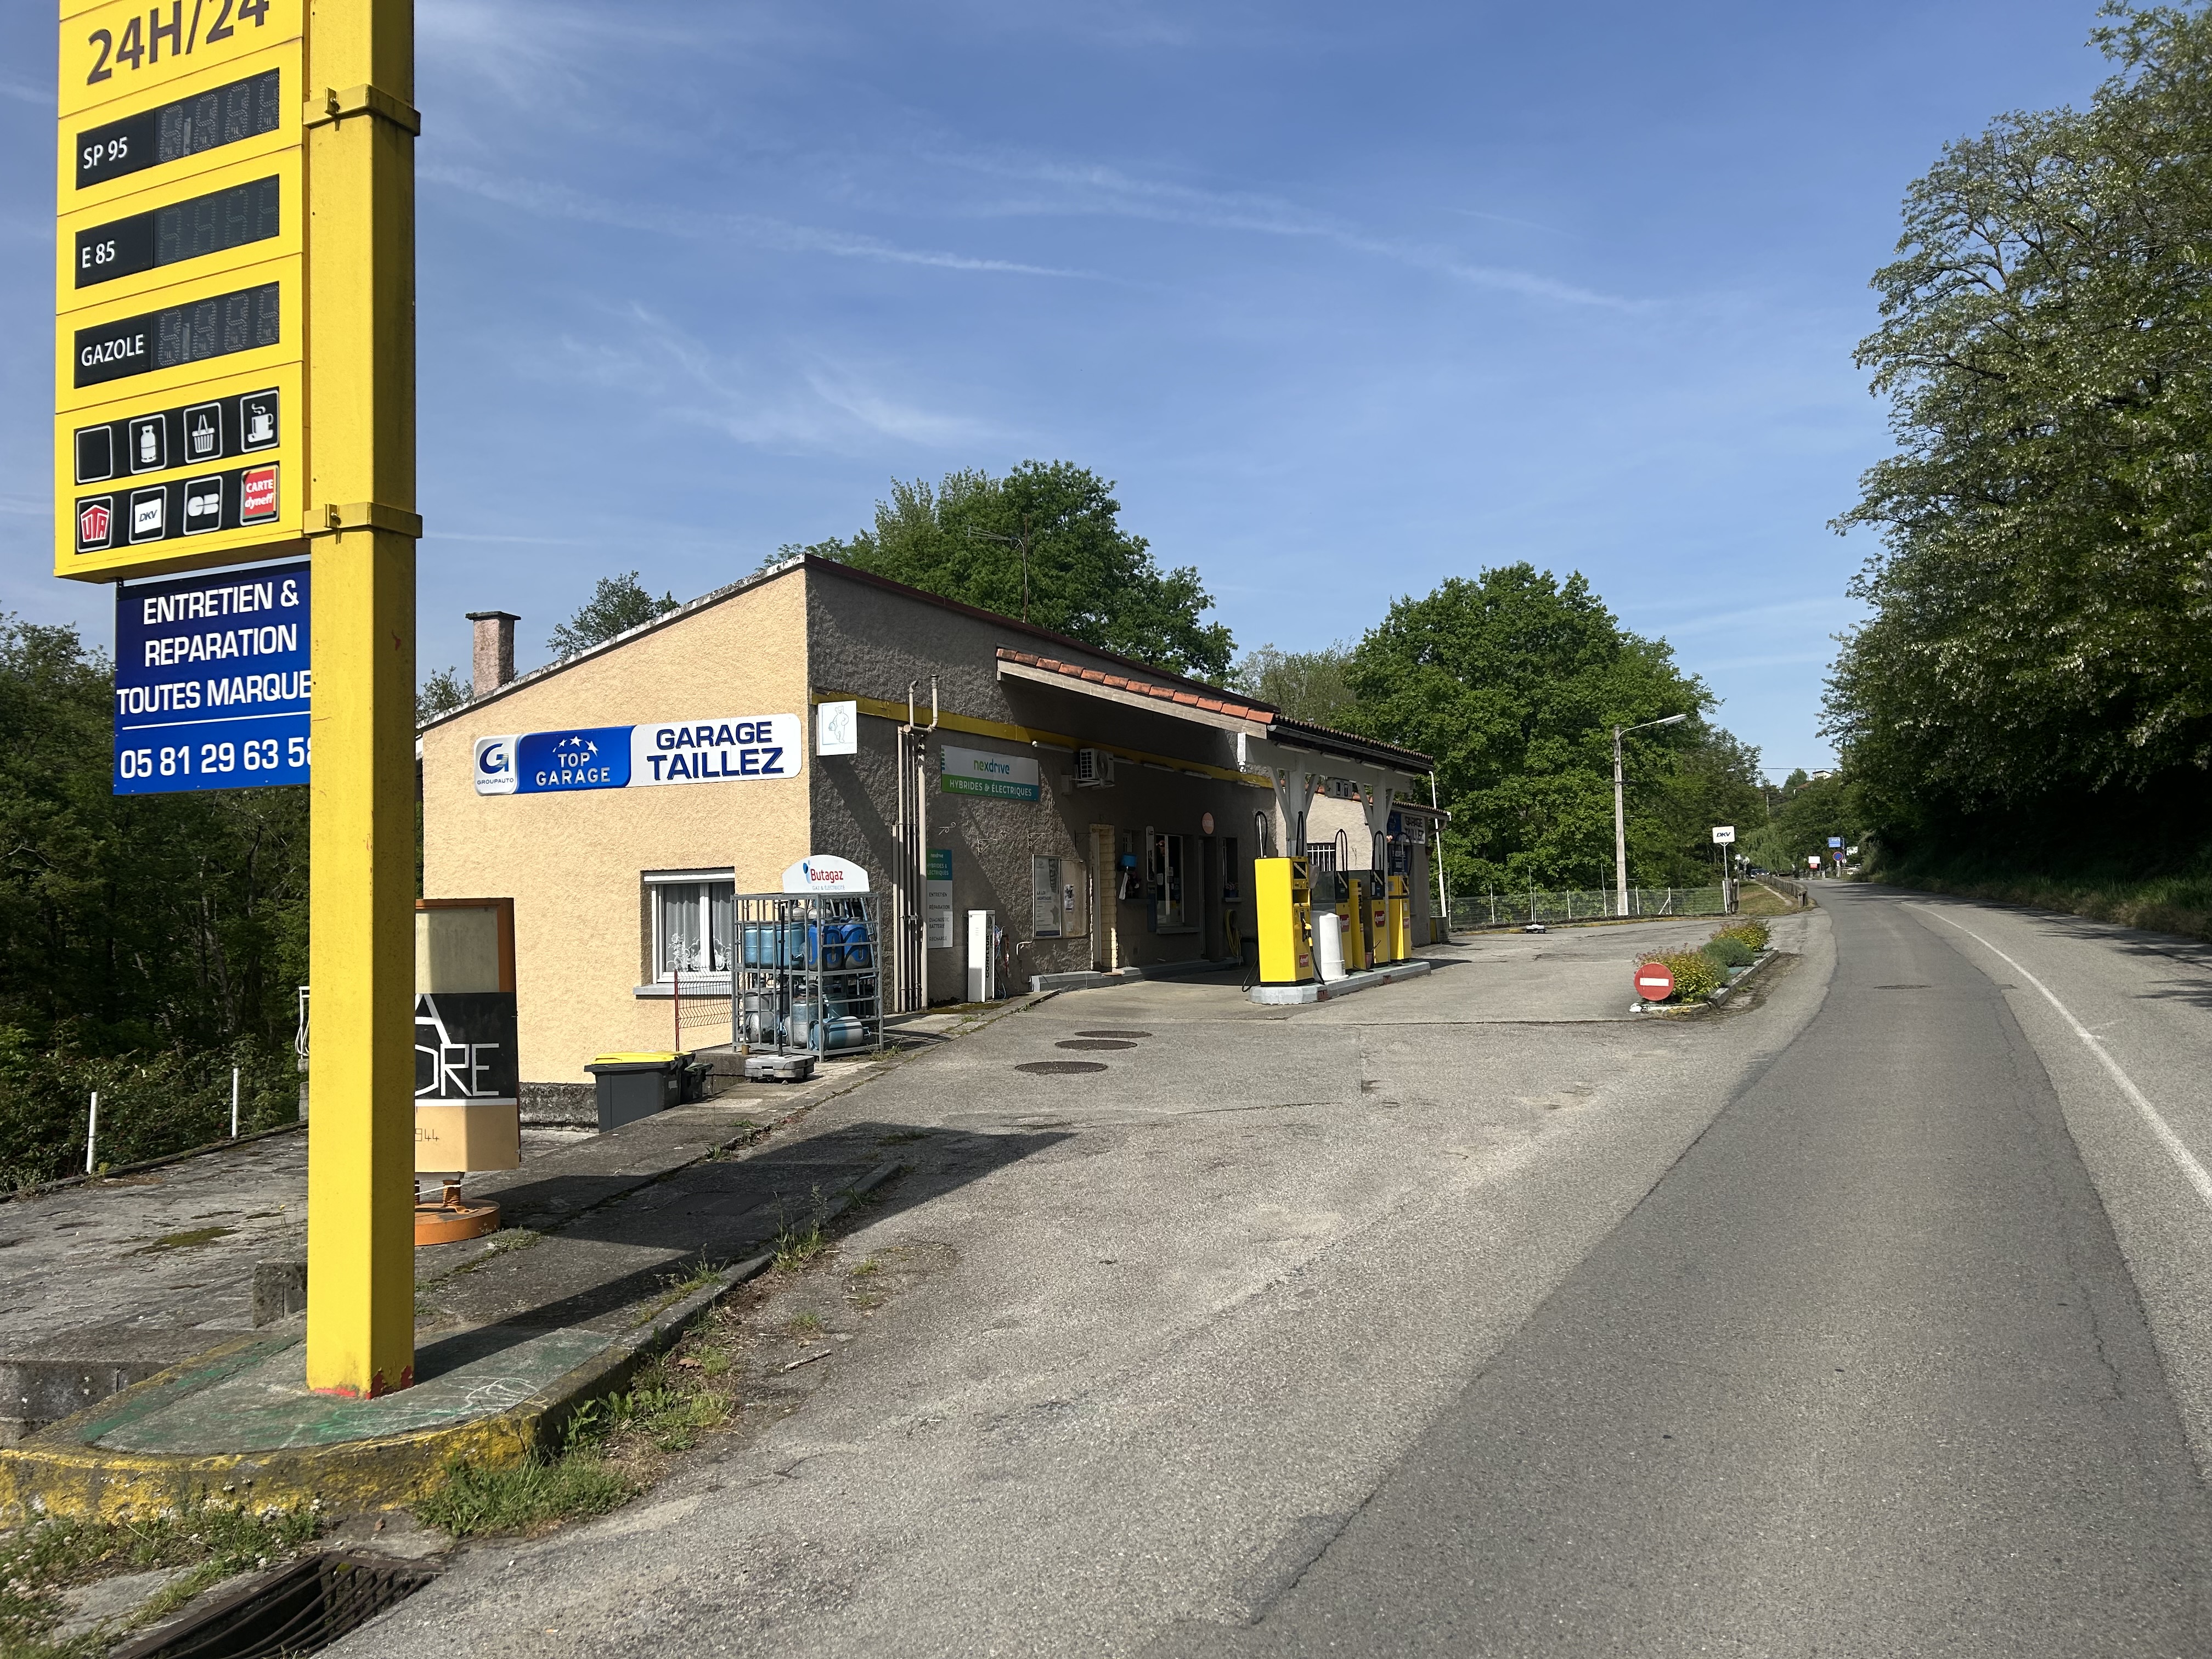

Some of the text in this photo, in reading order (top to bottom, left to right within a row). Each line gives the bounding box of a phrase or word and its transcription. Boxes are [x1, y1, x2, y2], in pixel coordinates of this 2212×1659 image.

[86, 0, 269, 86] 24H/24
[83, 137, 127, 169] SP 95
[82, 240, 115, 268] E 85
[81, 334, 145, 367] GAZOLE
[245, 492, 275, 509] dyneff
[246, 479, 274, 493] CARTE
[81, 506, 110, 541] UTA
[139, 509, 158, 522] DKV
[143, 579, 299, 625] ENTRETIEN &
[145, 624, 297, 667] REPARATION
[116, 670, 311, 715] TOUTES MARQUE
[656, 721, 772, 750] GARAGE
[120, 737, 311, 778] 05 81 29 63 5
[558, 753, 590, 768] TOP
[647, 747, 784, 781] TAILLEZ
[974, 758, 1010, 775] nexdrive
[536, 767, 611, 786] GARAGE
[950, 779, 1032, 797] HYBRIDES & ÉLECTRIQUES
[810, 868, 843, 884] Butagaz
